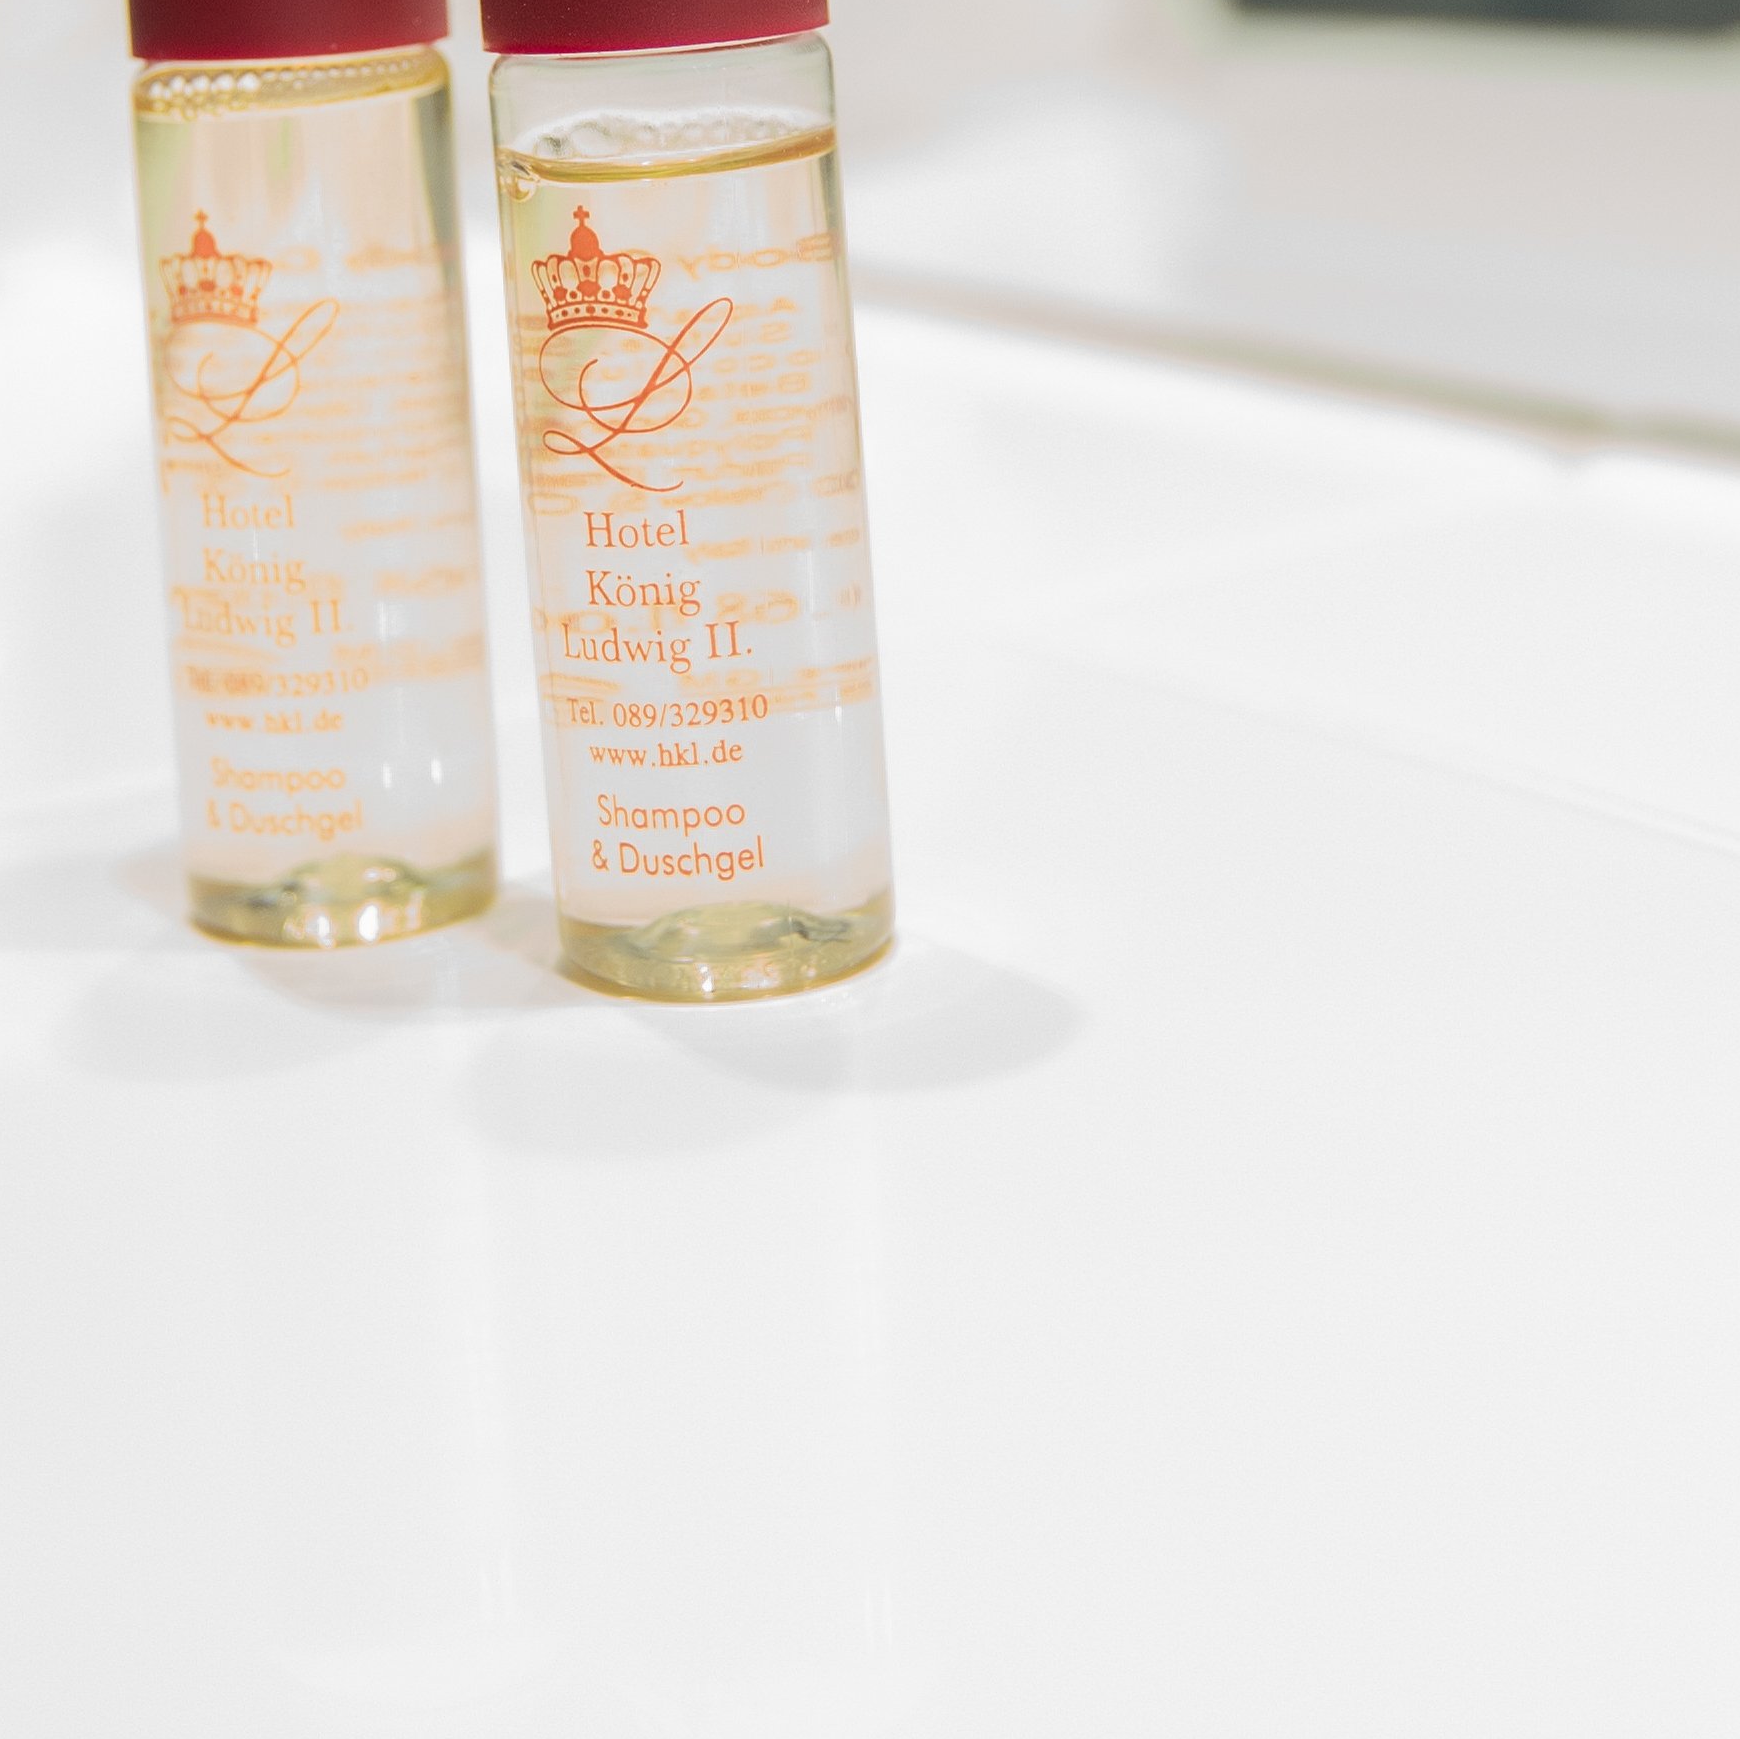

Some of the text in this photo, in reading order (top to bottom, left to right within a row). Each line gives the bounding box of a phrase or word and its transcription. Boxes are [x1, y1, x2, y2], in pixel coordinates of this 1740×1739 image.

[200, 493, 296, 530] Hotel
[584, 510, 689, 548] Hotel
[203, 547, 306, 593] König
[586, 569, 701, 616] König
[180, 594, 297, 647] Ludwig
[562, 620, 753, 673] Ludwig II.
[566, 693, 769, 728] Tel. 089/329310
[589, 738, 744, 767] www.hkl.de
[210, 757, 346, 797] Shampoo
[229, 799, 362, 841] Duschgel
[596, 793, 746, 837] Shampoo
[591, 835, 765, 881] & Duschgel
